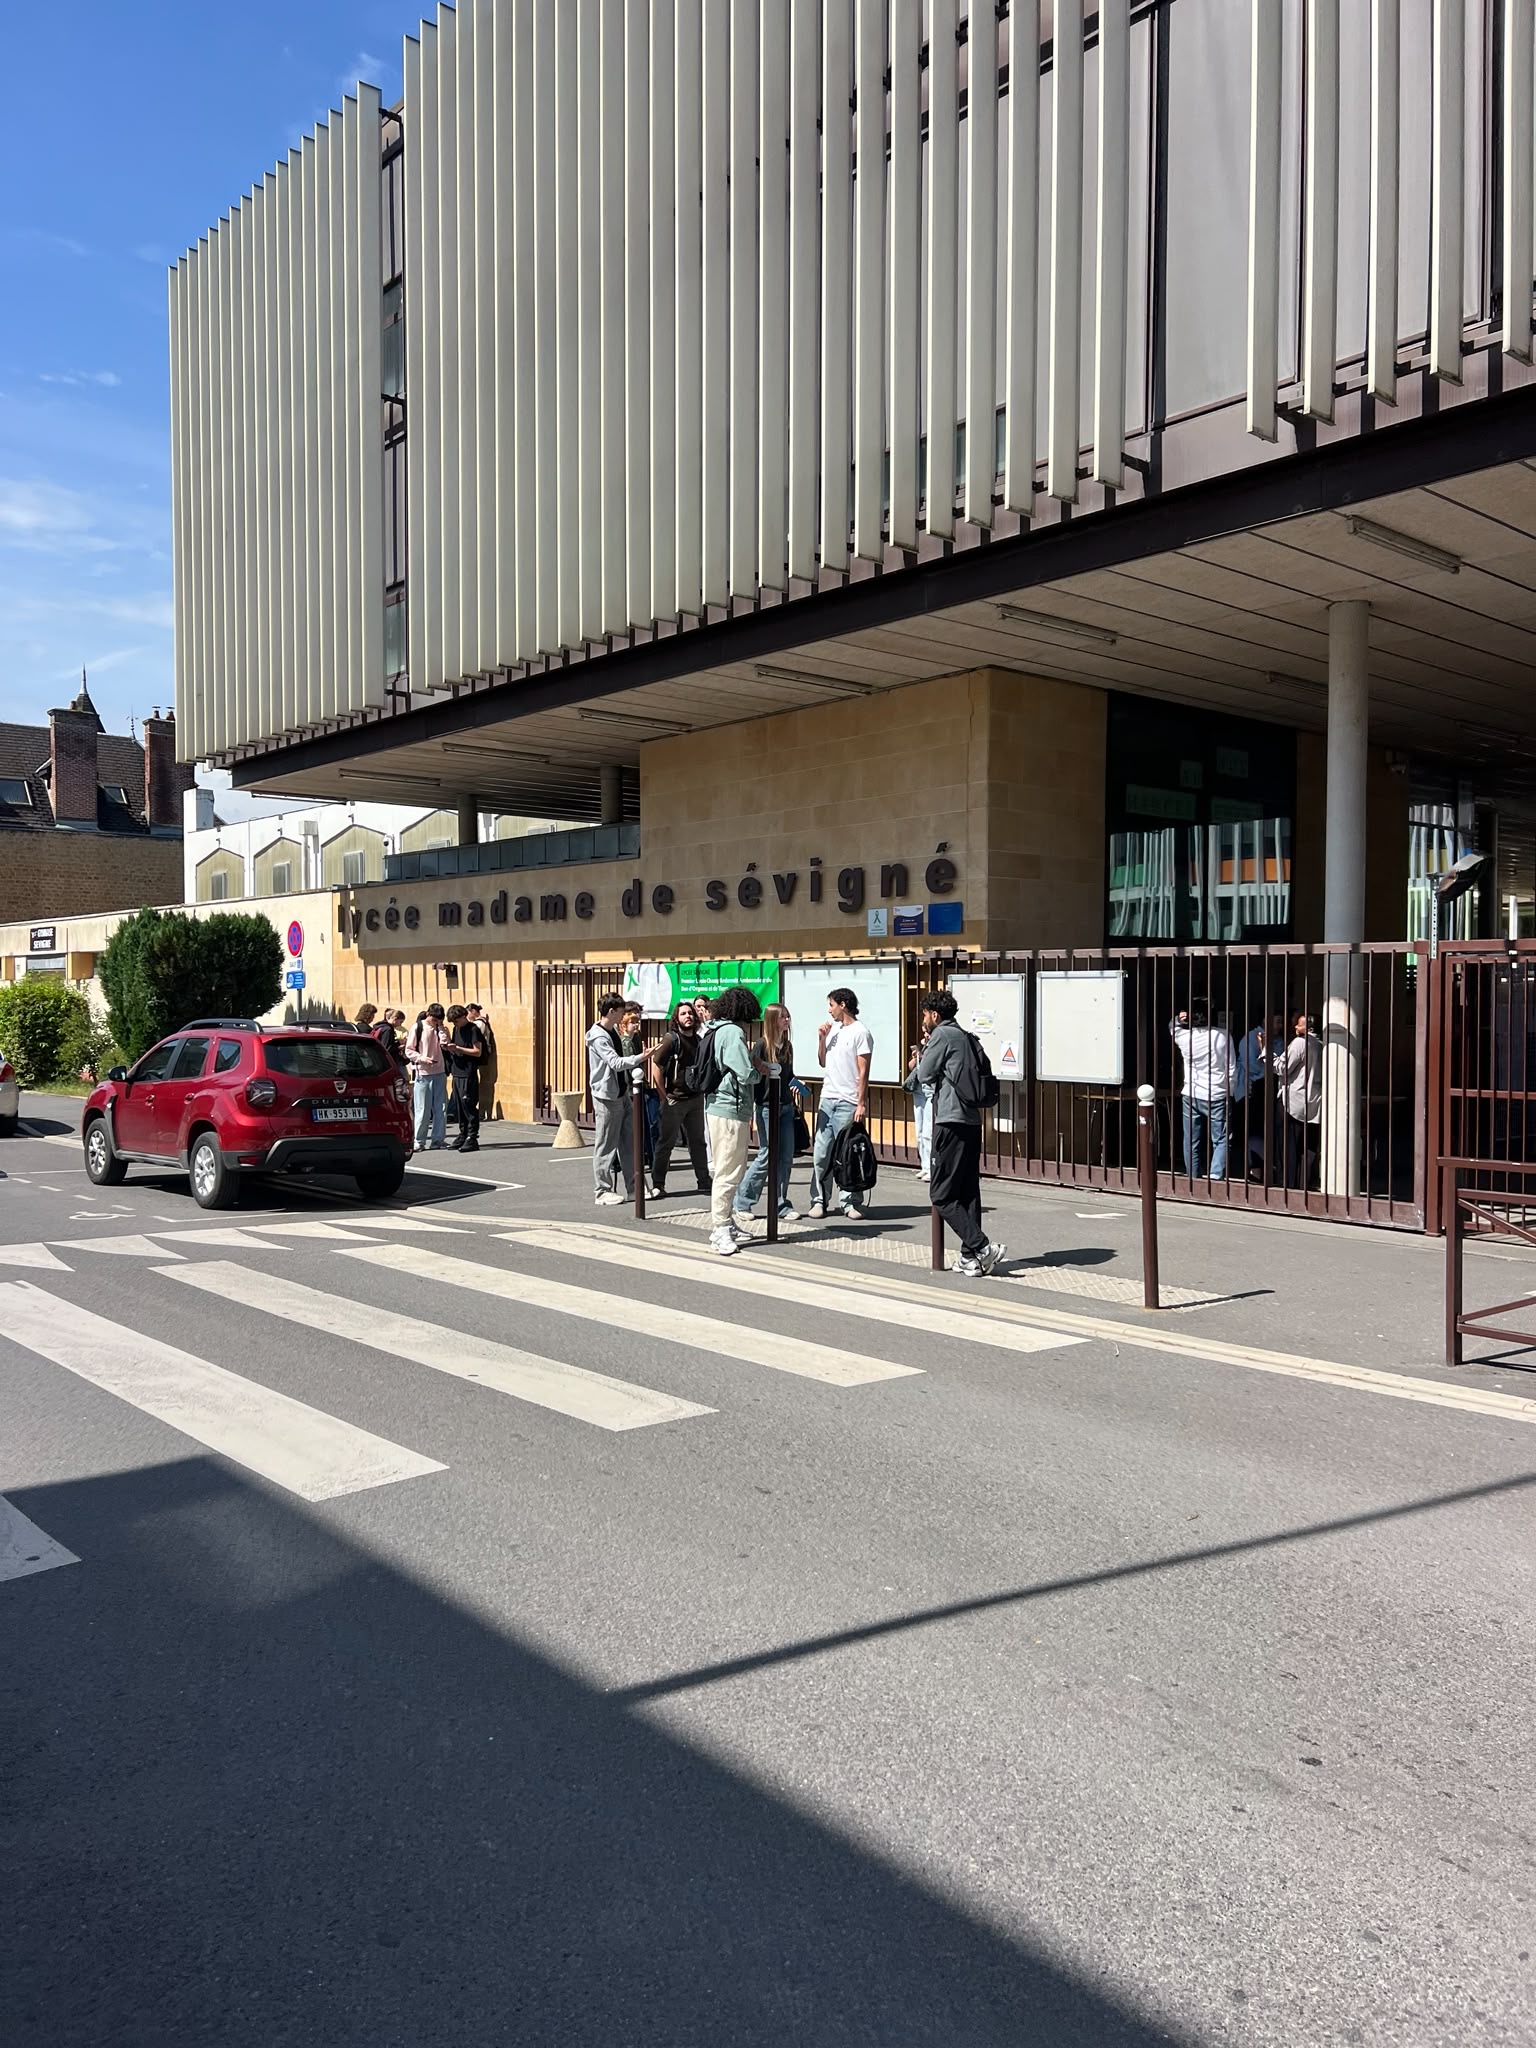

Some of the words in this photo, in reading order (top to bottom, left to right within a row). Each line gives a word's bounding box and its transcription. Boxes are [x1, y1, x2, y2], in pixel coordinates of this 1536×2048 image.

[337, 896, 420, 943] lycée
[438, 889, 595, 927] madame
[621, 878, 674, 918] de
[705, 841, 957, 914] sévigné
